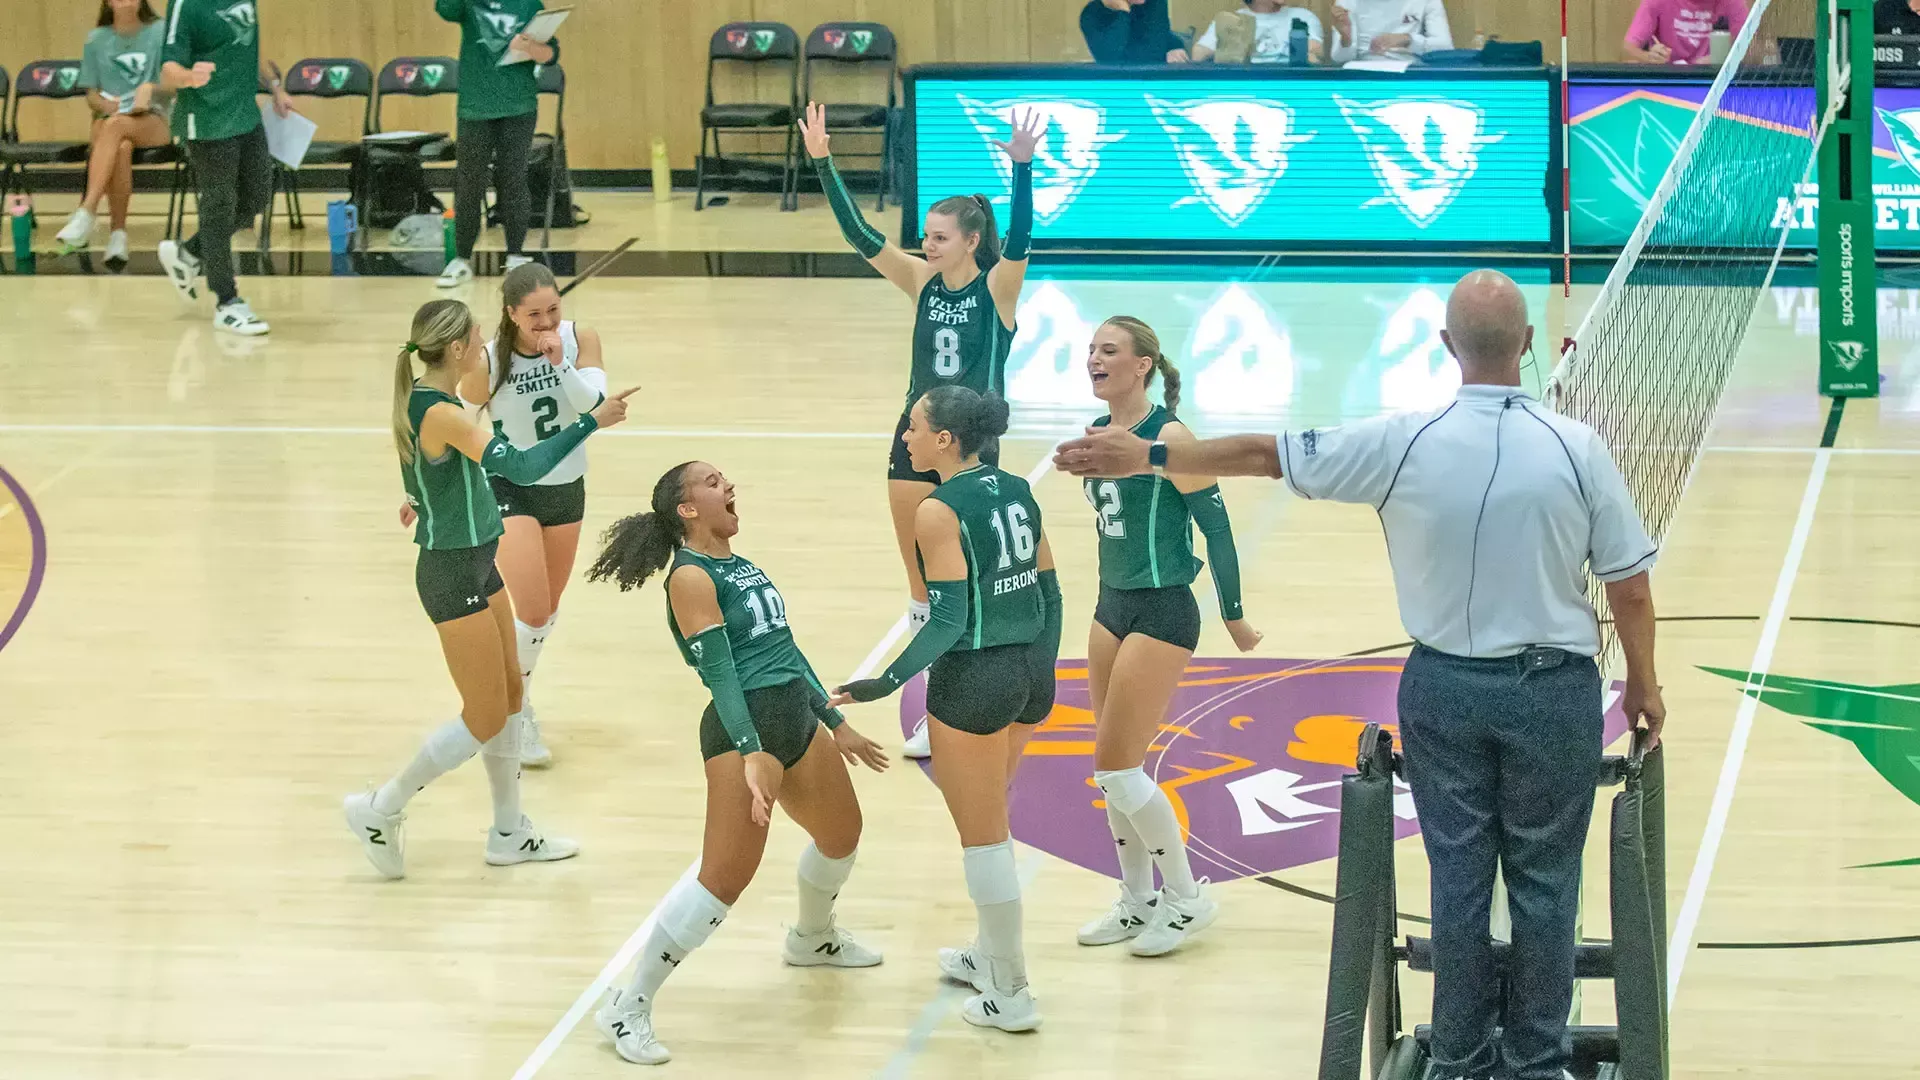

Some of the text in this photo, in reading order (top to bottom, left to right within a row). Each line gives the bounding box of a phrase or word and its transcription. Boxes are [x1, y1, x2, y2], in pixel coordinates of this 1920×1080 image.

[1838, 223, 1854, 326] sports imports
[928, 295, 978, 314] WILLIAM
[928, 309, 969, 325] SMITH
[932, 326, 962, 378] 8
[531, 396, 561, 441] 2
[989, 501, 1034, 572] 16
[743, 586, 787, 639] 10
